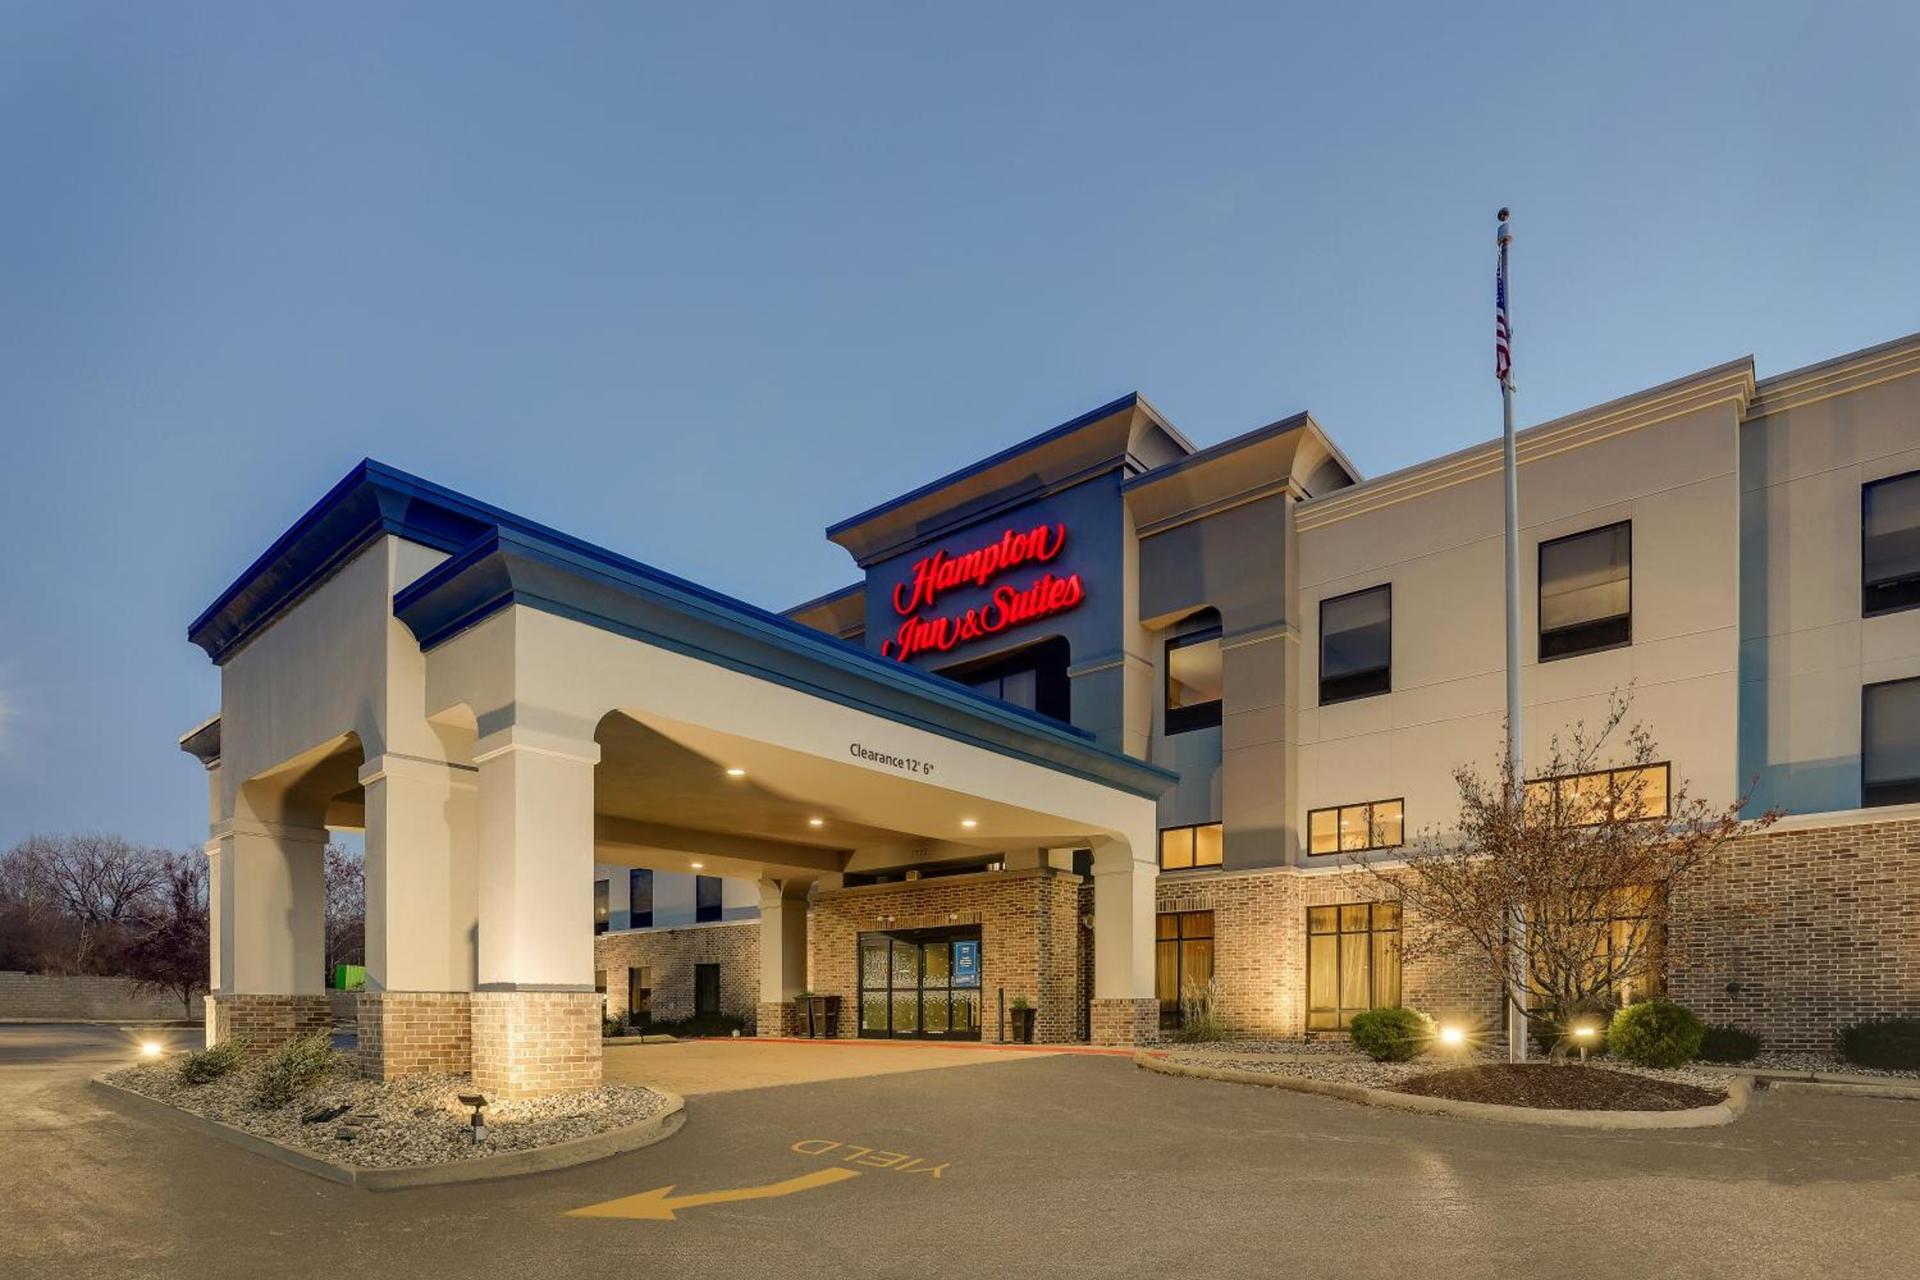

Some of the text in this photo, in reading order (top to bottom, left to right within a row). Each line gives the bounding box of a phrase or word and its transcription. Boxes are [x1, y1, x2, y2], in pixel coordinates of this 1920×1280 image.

[893, 522, 1066, 616] Hampton
[881, 573, 1085, 662] Inn & Suites
[850, 743, 904, 769] Clearance
[791, 1139, 950, 1179] YIELD
